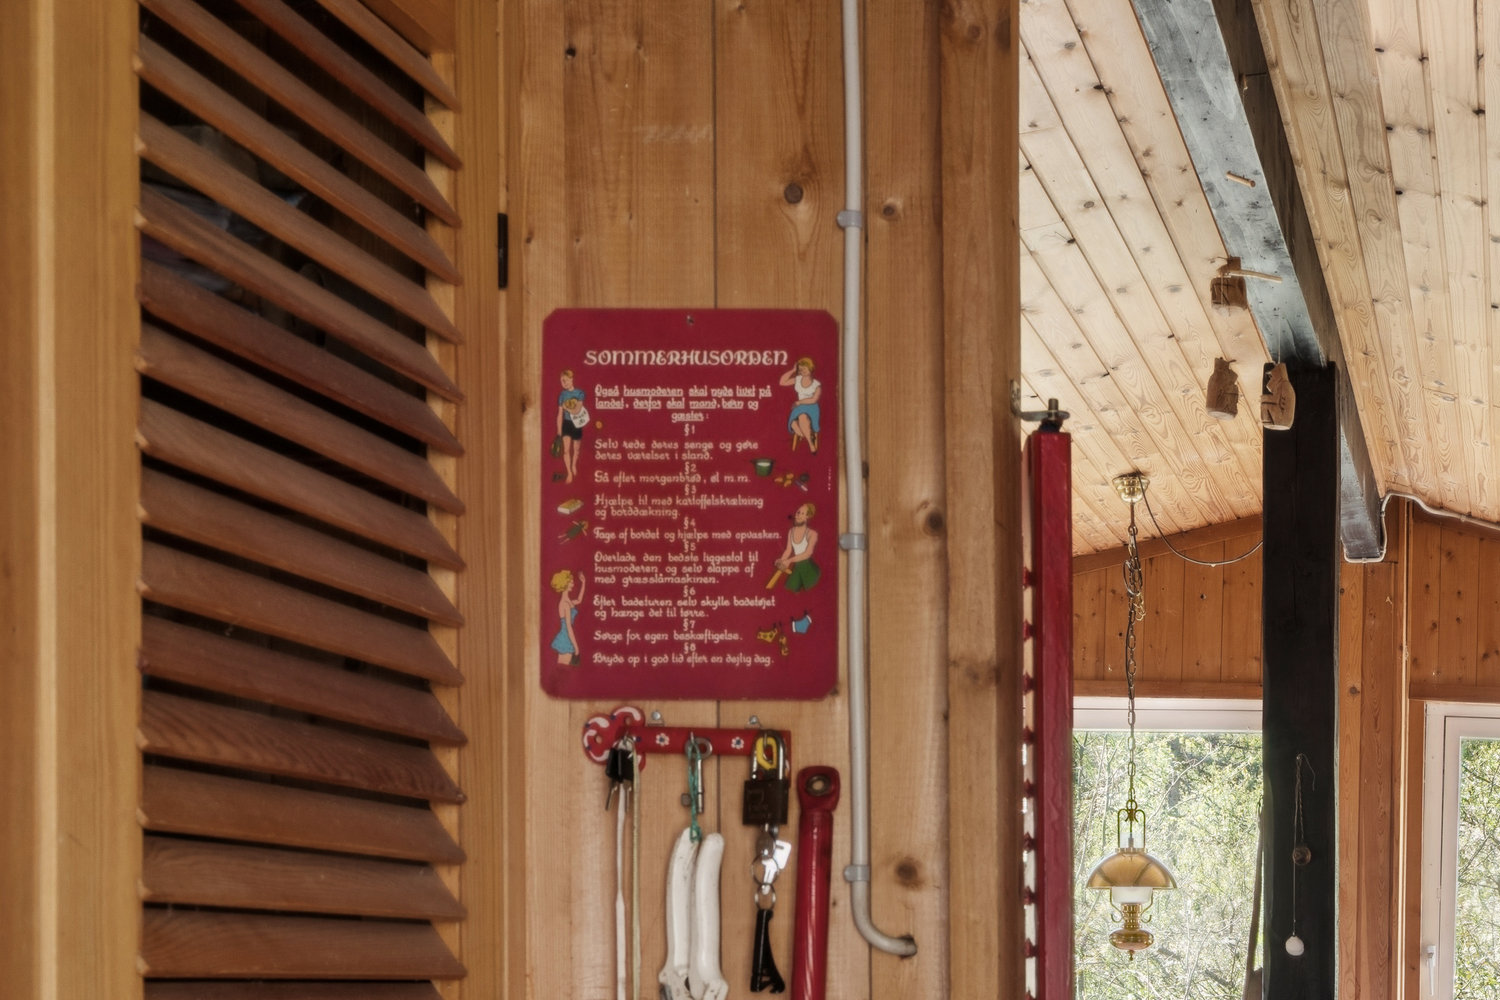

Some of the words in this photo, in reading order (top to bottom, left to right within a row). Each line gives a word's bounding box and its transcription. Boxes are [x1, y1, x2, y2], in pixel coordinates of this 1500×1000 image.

[584, 350, 788, 366] SOMMERHUSORDEN
[624, 385, 683, 397] husmoderen
[689, 386, 707, 397] skal
[711, 386, 733, 398] nyde
[737, 385, 755, 397] livet
[759, 385, 772, 399] på
[667, 398, 685, 409] skal
[748, 400, 758, 410] og
[594, 439, 618, 450] Selv
[623, 440, 645, 450] rede
[652, 440, 679, 450] deres
[685, 442, 713, 452] senge
[720, 442, 731, 452] og
[736, 441, 758, 452] gøre
[595, 451, 622, 460] deres
[628, 451, 670, 460] værelser
[675, 451, 678, 460] i
[613, 471, 635, 487] efter
[594, 494, 633, 507] Hjælpe
[639, 495, 647, 506] til
[652, 496, 672, 506] med
[595, 509, 606, 520] og
[594, 527, 616, 542] Tage
[619, 528, 627, 544] af
[631, 528, 659, 539] bordet
[664, 531, 675, 542] og
[678, 528, 708, 542] hjælpe
[712, 530, 731, 539] med
[594, 552, 636, 562] Overlade
[643, 553, 662, 562] den
[668, 552, 699, 562] bedste
[703, 552, 743, 564] liggestol
[749, 552, 758, 562] til
[595, 564, 658, 573] husmoderen
[666, 566, 677, 576] og
[682, 563, 702, 573] selv
[707, 563, 739, 576] slappe
[745, 563, 754, 577] af
[595, 575, 616, 584] med
[622, 596, 672, 606] badeturen
[677, 596, 697, 606] selv
[701, 596, 730, 610] skylle
[734, 596, 775, 609] badetøjet
[594, 610, 606, 621] og
[611, 608, 644, 621] hænge
[649, 608, 663, 617] det
[667, 608, 676, 617] til
[593, 630, 622, 643] Sørge
[627, 629, 641, 645] for
[645, 632, 668, 643] egen
[593, 653, 624, 667] Bryde
[628, 655, 639, 667] op
[644, 655, 647, 663] i
[651, 654, 669, 667] god
[672, 653, 684, 663] tid
[687, 653, 708, 667] efter
[726, 653, 751, 667] dejlig
